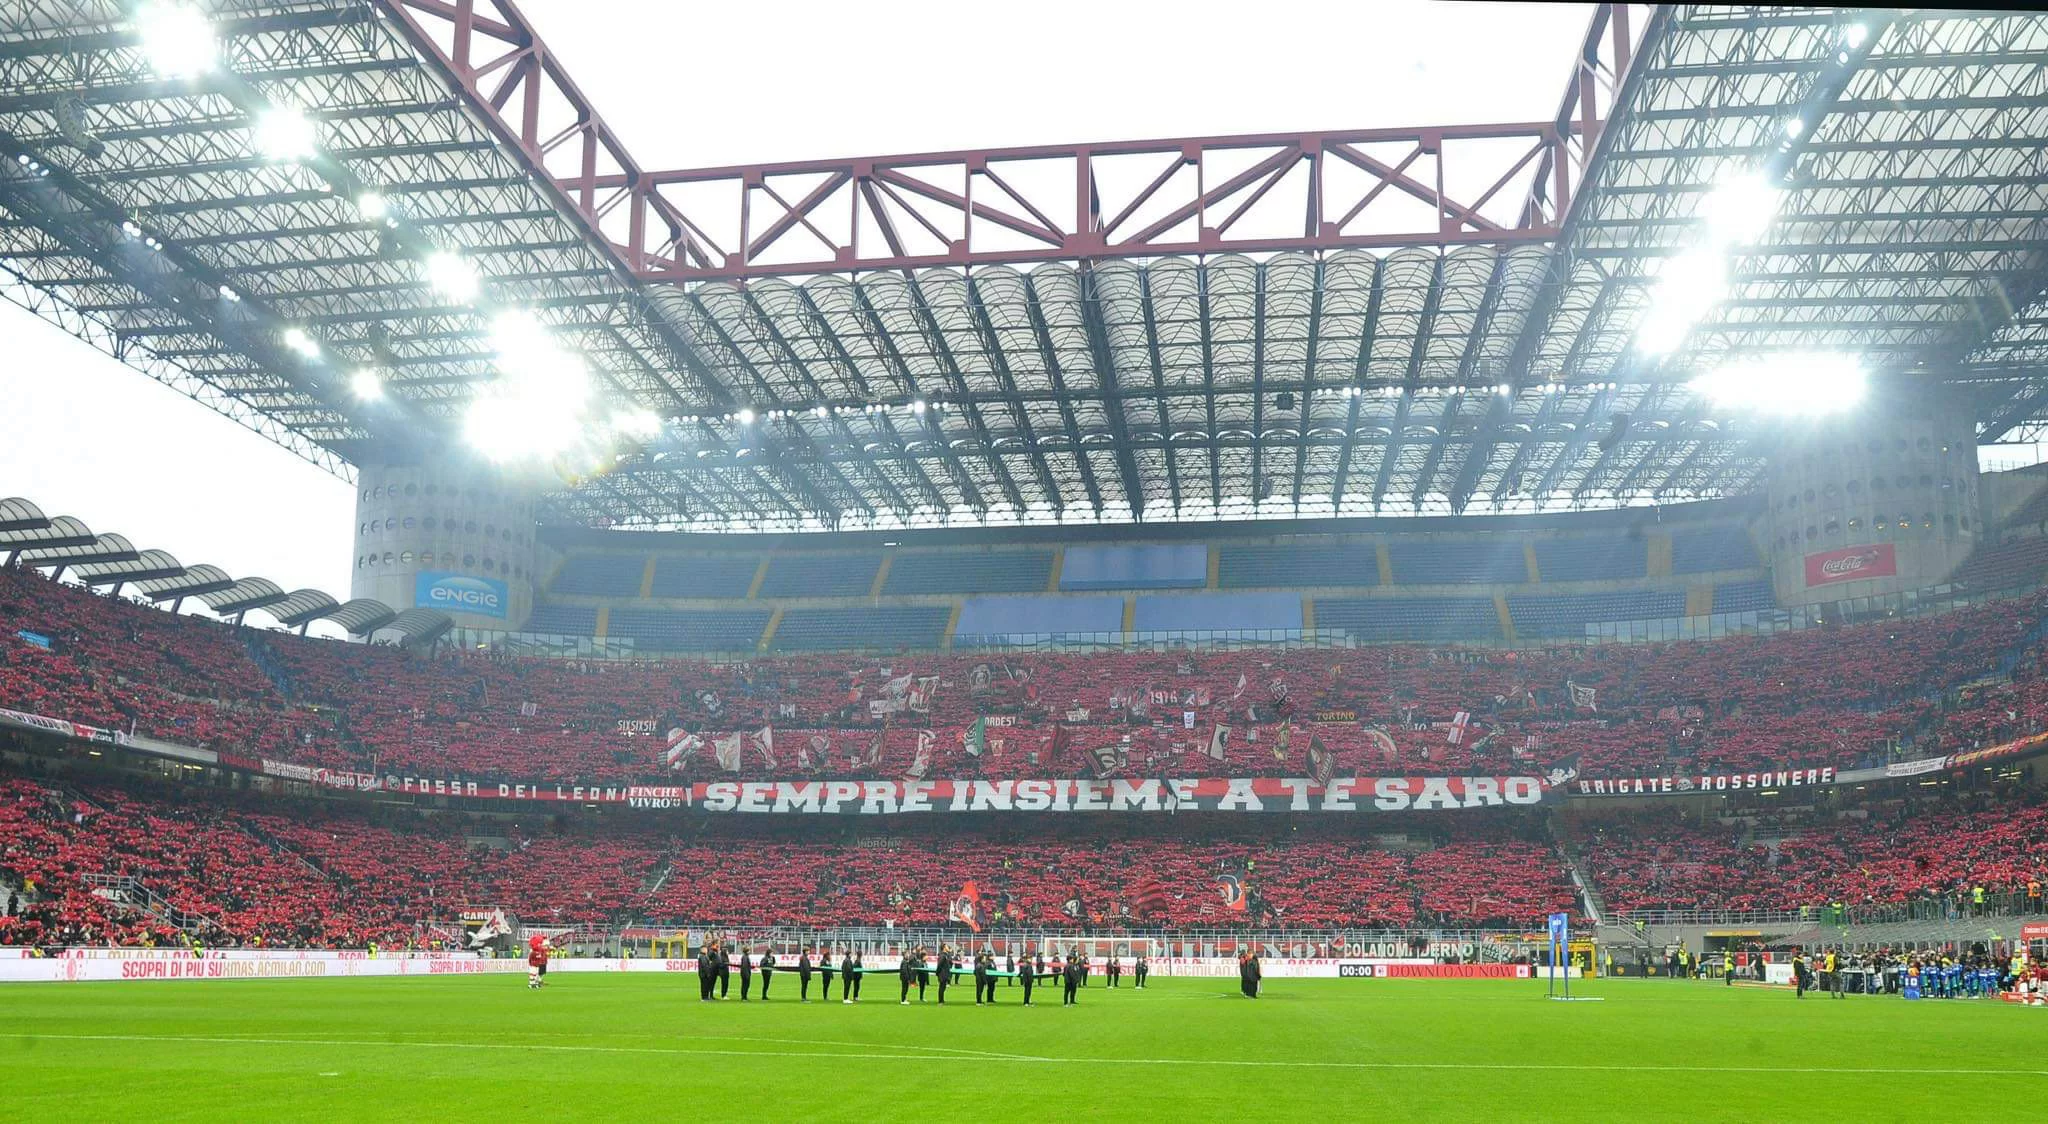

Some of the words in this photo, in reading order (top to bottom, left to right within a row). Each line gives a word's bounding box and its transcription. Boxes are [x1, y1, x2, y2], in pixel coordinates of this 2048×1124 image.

[324, 770, 355, 788] Angelo
[1579, 777, 1671, 795] BRIGATE
[1701, 767, 1833, 791] ROSSONERE
[404, 777, 478, 797] FOSSA
[499, 784, 537, 799] DEI
[557, 786, 627, 801] LEONI
[702, 780, 935, 814] SEMPRE
[949, 779, 1199, 812] INSIEME
[1217, 777, 1263, 811] A
[1281, 777, 1357, 811] TE
[1374, 775, 1542, 811] SARO
[122, 960, 167, 978] SCOPRI
[170, 960, 182, 977] DI
[430, 960, 454, 973] SCOPRI
[1341, 965, 1372, 977] 00:00
[1391, 965, 1474, 978] DOWNLOAD
[1479, 965, 1514, 978] NOW
